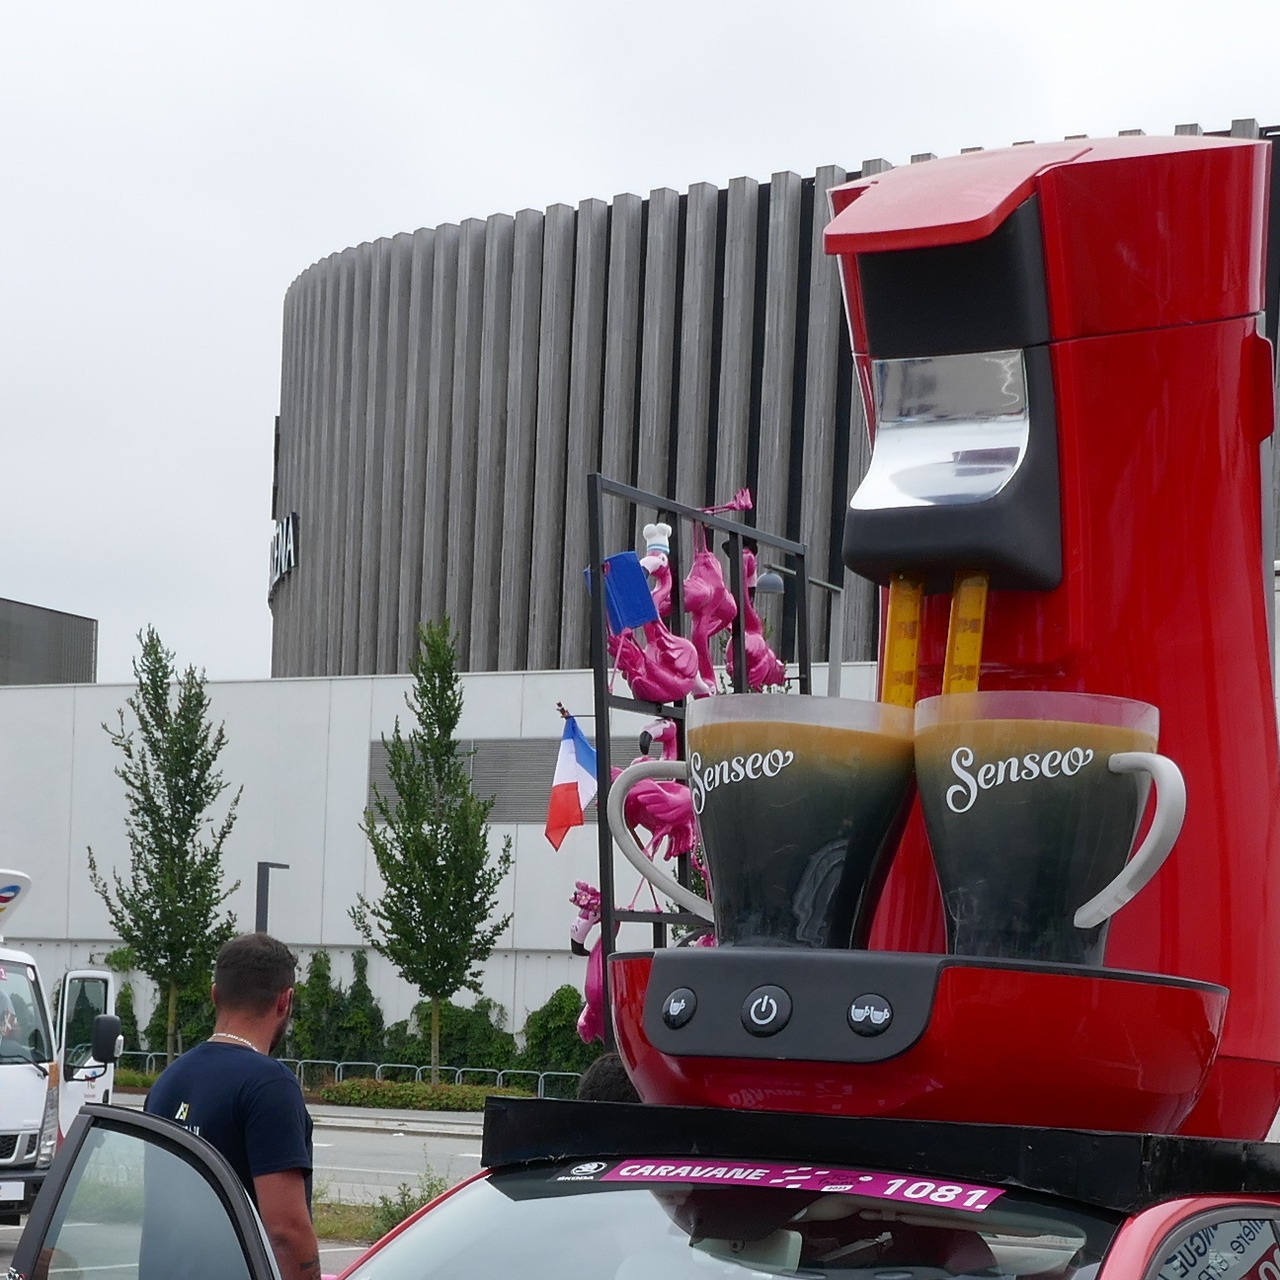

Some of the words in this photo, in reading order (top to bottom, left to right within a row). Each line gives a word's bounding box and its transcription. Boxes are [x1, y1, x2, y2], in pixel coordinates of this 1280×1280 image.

[690, 748, 794, 815] Senseo
[946, 746, 1094, 814] Senseo
[619, 1164, 771, 1182] CARAVANE
[883, 1178, 988, 1207] 1081
